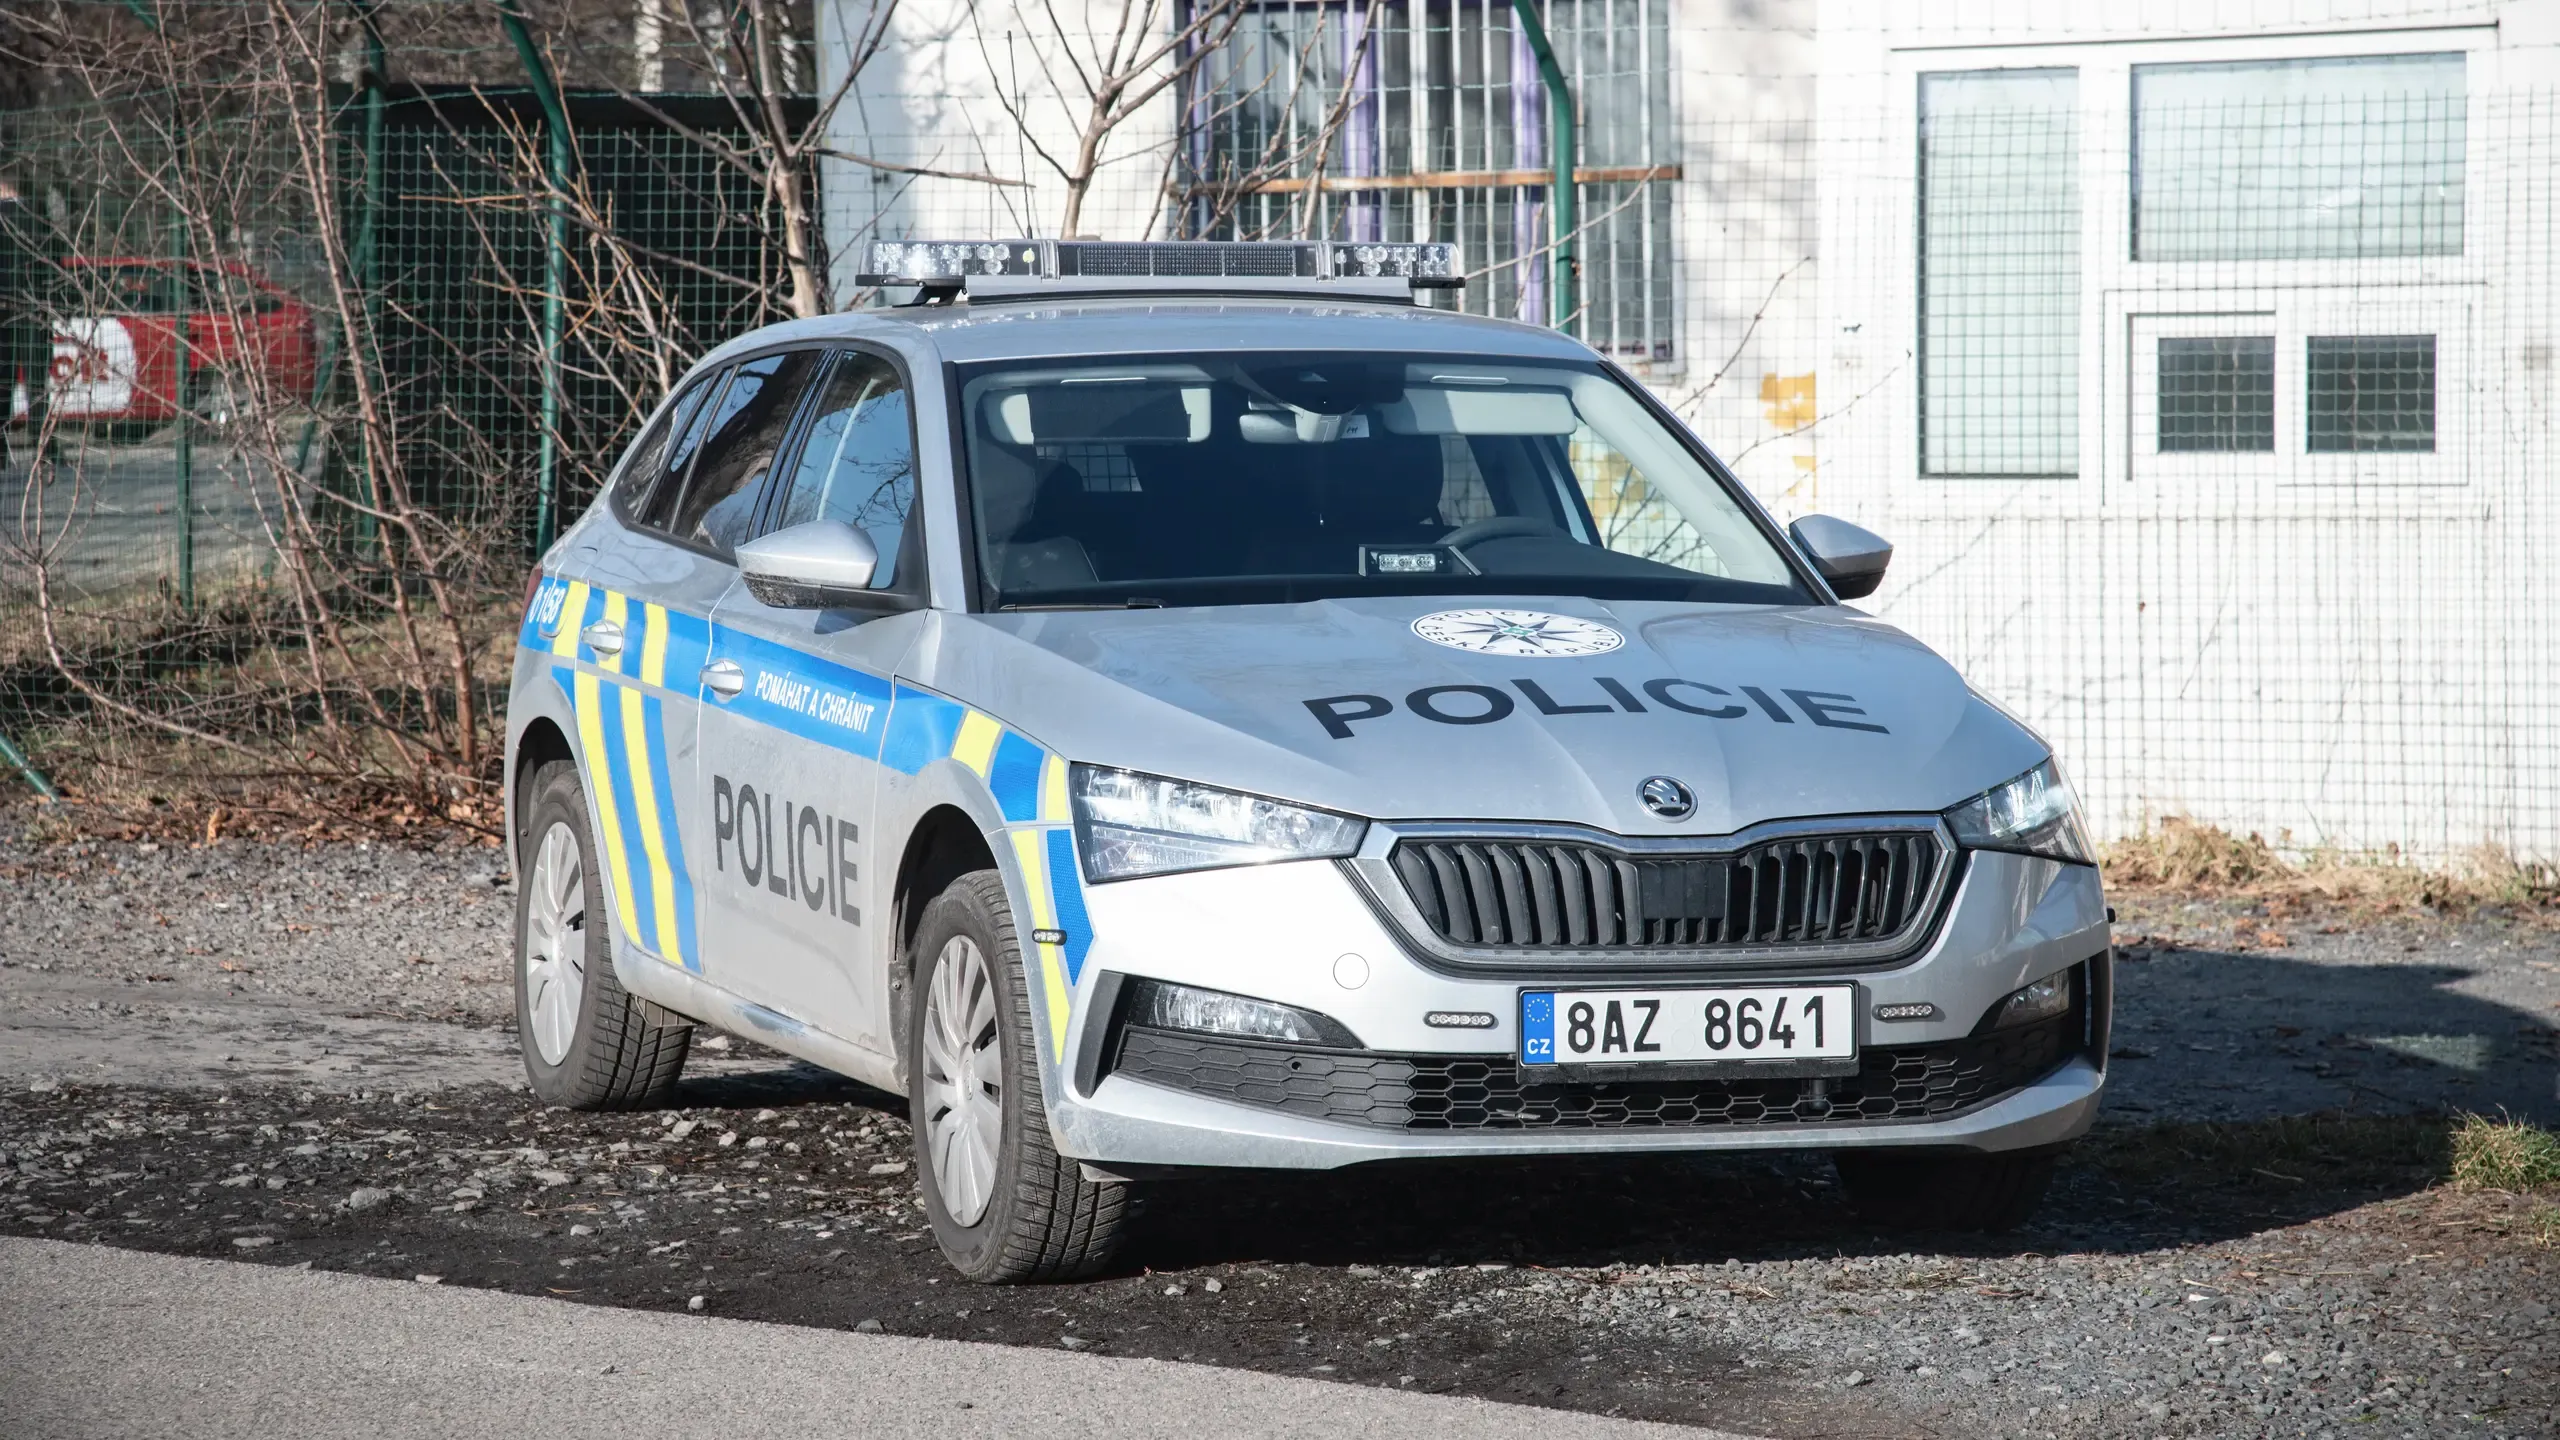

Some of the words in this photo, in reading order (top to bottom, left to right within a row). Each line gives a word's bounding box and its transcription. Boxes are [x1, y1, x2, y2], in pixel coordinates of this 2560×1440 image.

[755, 671, 811, 713] POMÁHAT
[807, 689, 819, 717] A
[819, 691, 875, 733] CHRÁNIT
[1302, 677, 1890, 740] POLICIE
[712, 774, 862, 928] POLICIE
[1526, 1040, 1551, 1056] CZ
[1567, 999, 1661, 1054] 8AZ
[1704, 996, 1827, 1051] 8641
